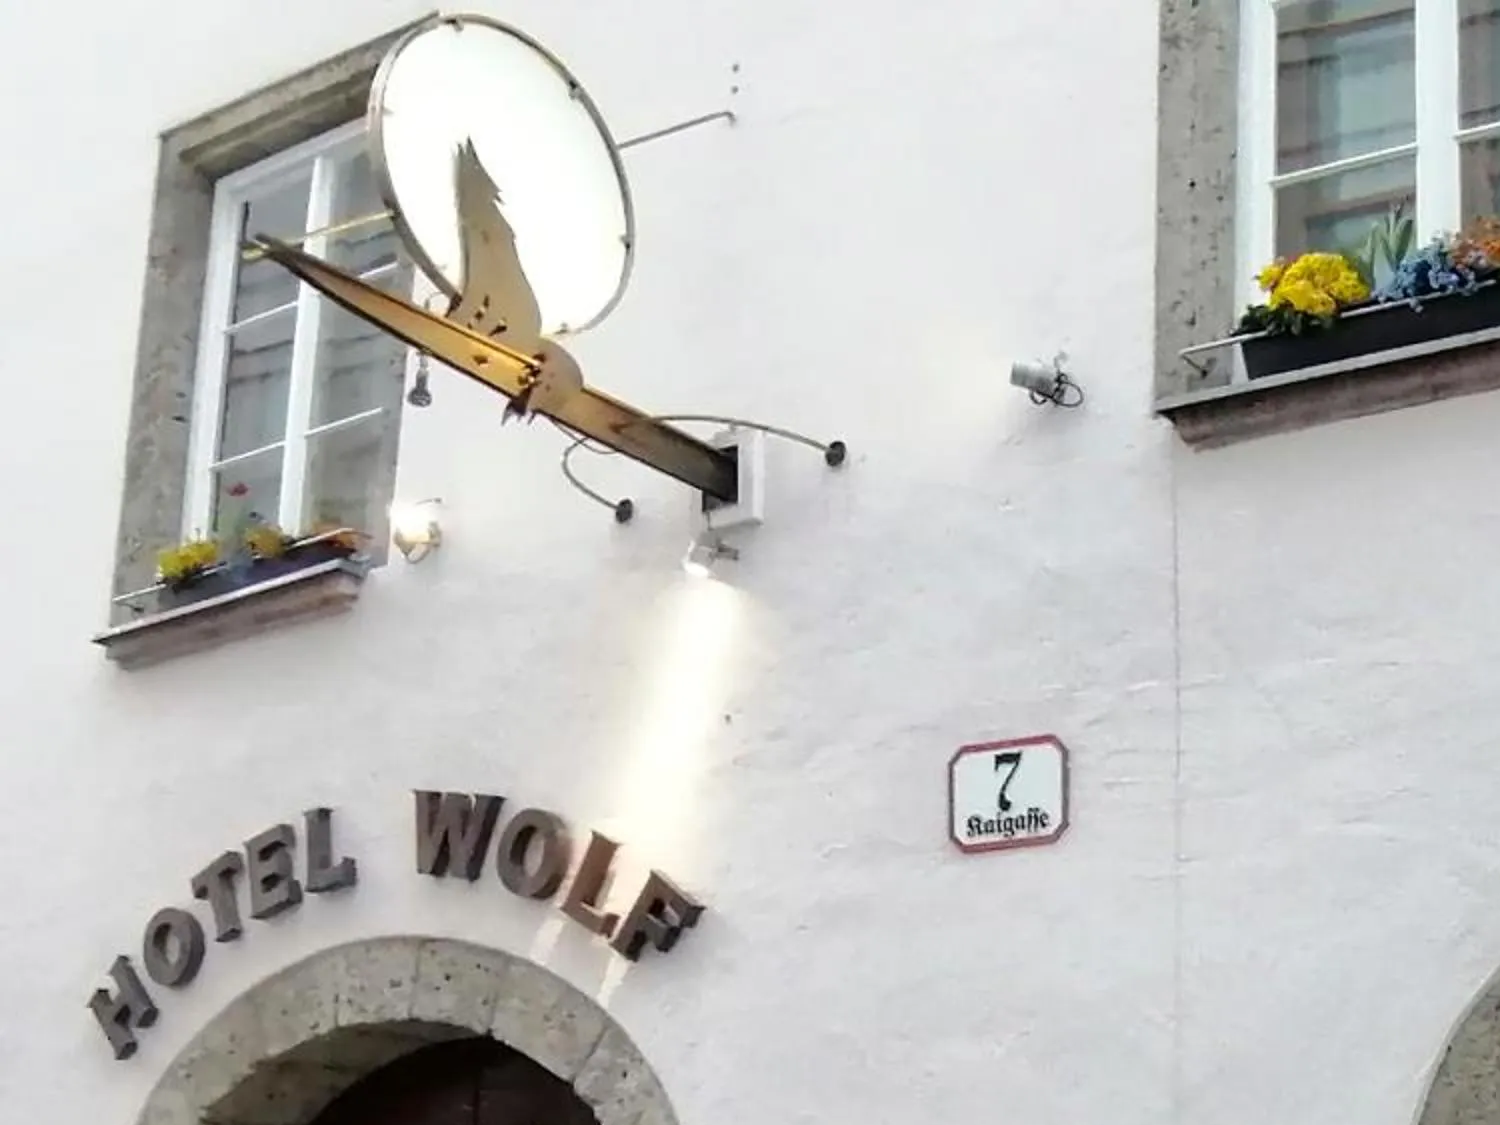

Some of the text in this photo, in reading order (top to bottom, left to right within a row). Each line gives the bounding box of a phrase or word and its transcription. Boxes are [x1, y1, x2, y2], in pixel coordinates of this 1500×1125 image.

[994, 750, 1023, 812] 7
[87, 789, 704, 1060] HOTEL WOLF
